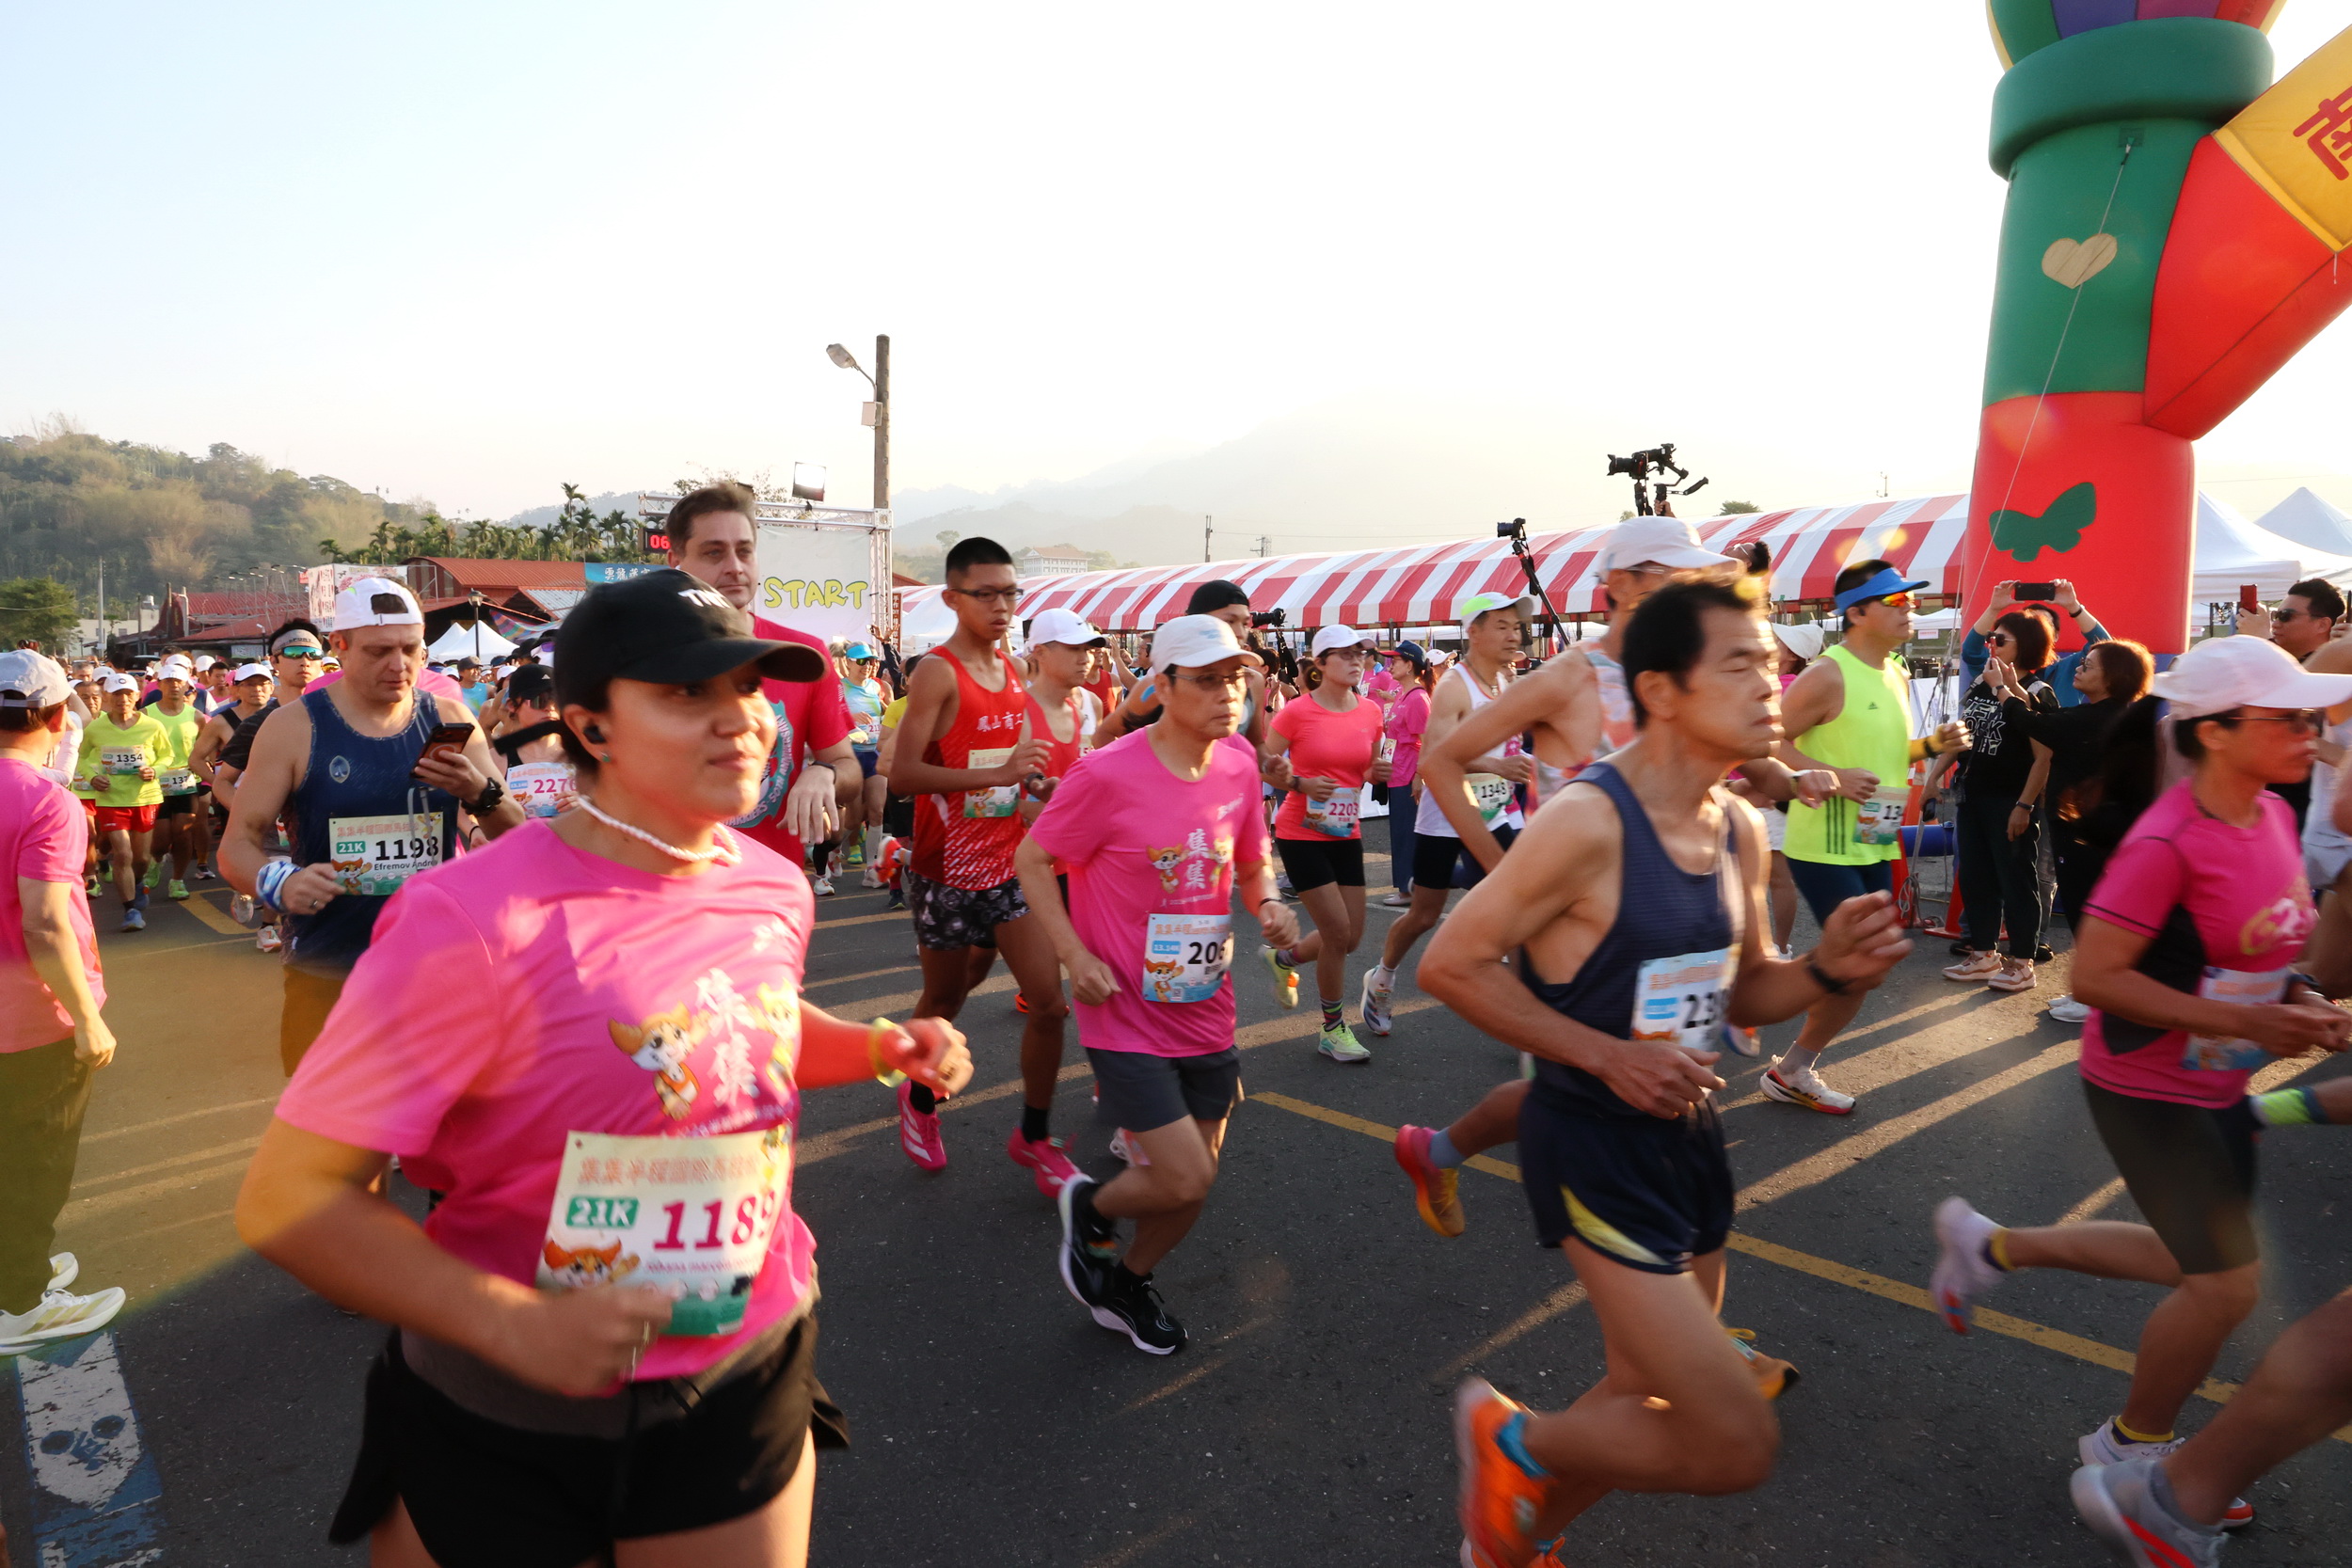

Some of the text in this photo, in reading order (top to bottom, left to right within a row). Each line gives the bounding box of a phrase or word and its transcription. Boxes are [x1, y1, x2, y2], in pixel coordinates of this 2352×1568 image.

[764, 577, 868, 610] START
[116, 753, 143, 763] 1354
[339, 842, 364, 853] 21K
[375, 836, 439, 861] 1198
[373, 862, 411, 871] Efremov
[570, 1199, 631, 1227] 21K
